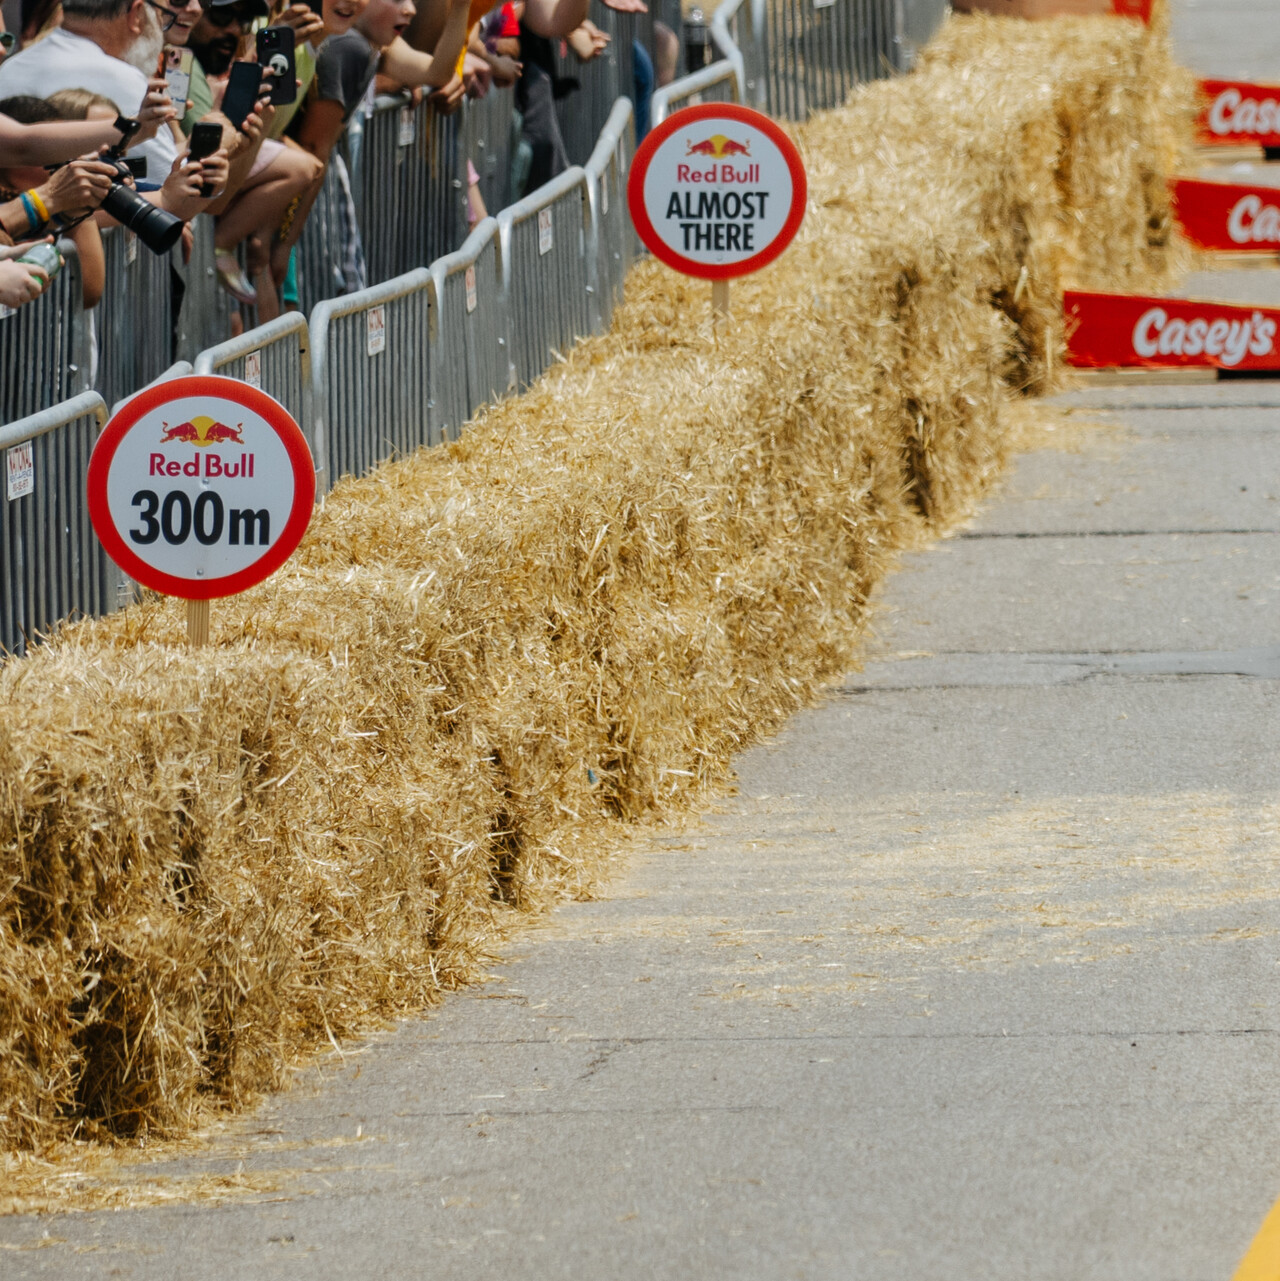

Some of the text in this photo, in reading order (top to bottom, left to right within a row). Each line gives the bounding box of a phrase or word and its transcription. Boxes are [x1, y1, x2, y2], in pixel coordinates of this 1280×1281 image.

[677, 164, 760, 184] Red Bull
[665, 191, 769, 220] ALMOST
[679, 223, 754, 251] THERE
[1132, 307, 1277, 366] Casey's
[149, 452, 255, 478] Red Bull
[129, 489, 271, 546] 300m
